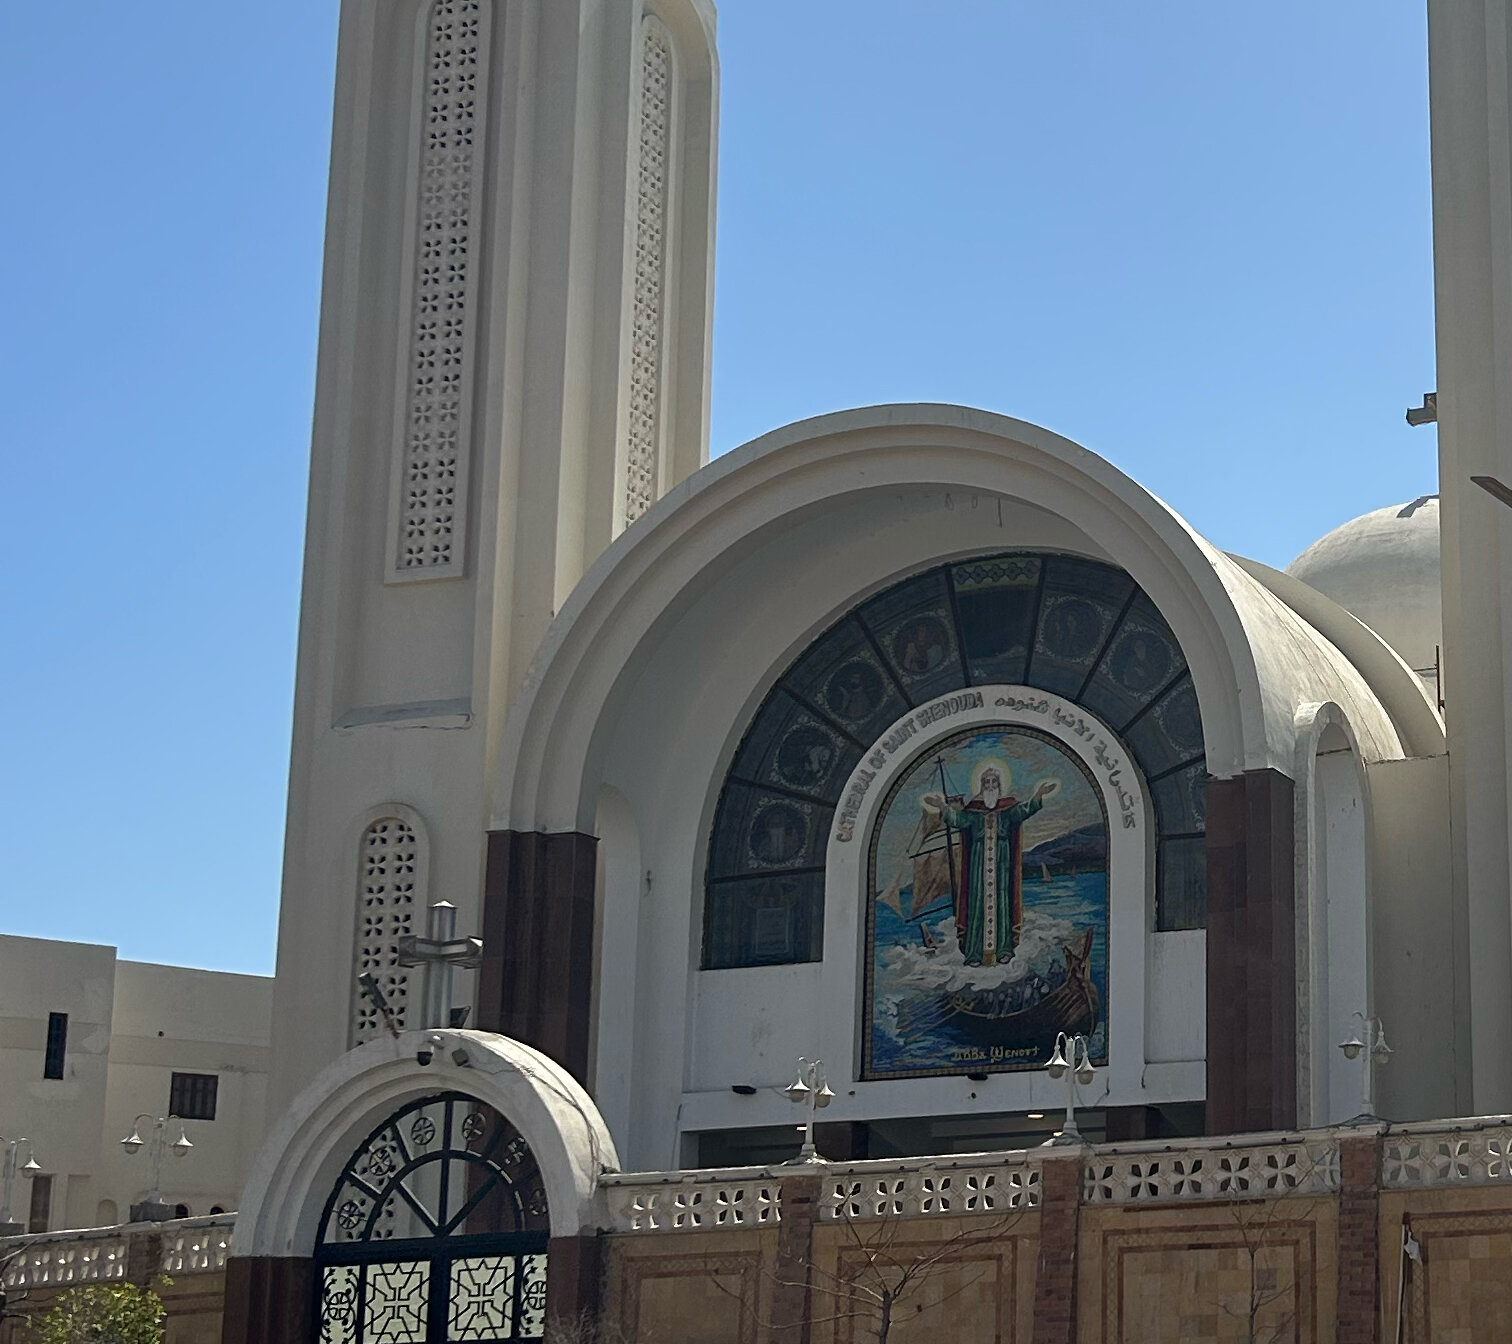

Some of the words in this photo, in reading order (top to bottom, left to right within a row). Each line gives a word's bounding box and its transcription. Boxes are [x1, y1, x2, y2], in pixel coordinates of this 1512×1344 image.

[869, 749, 888, 769] OF
[883, 718, 920, 754] SAINT
[916, 692, 985, 728] SHENOUDA
